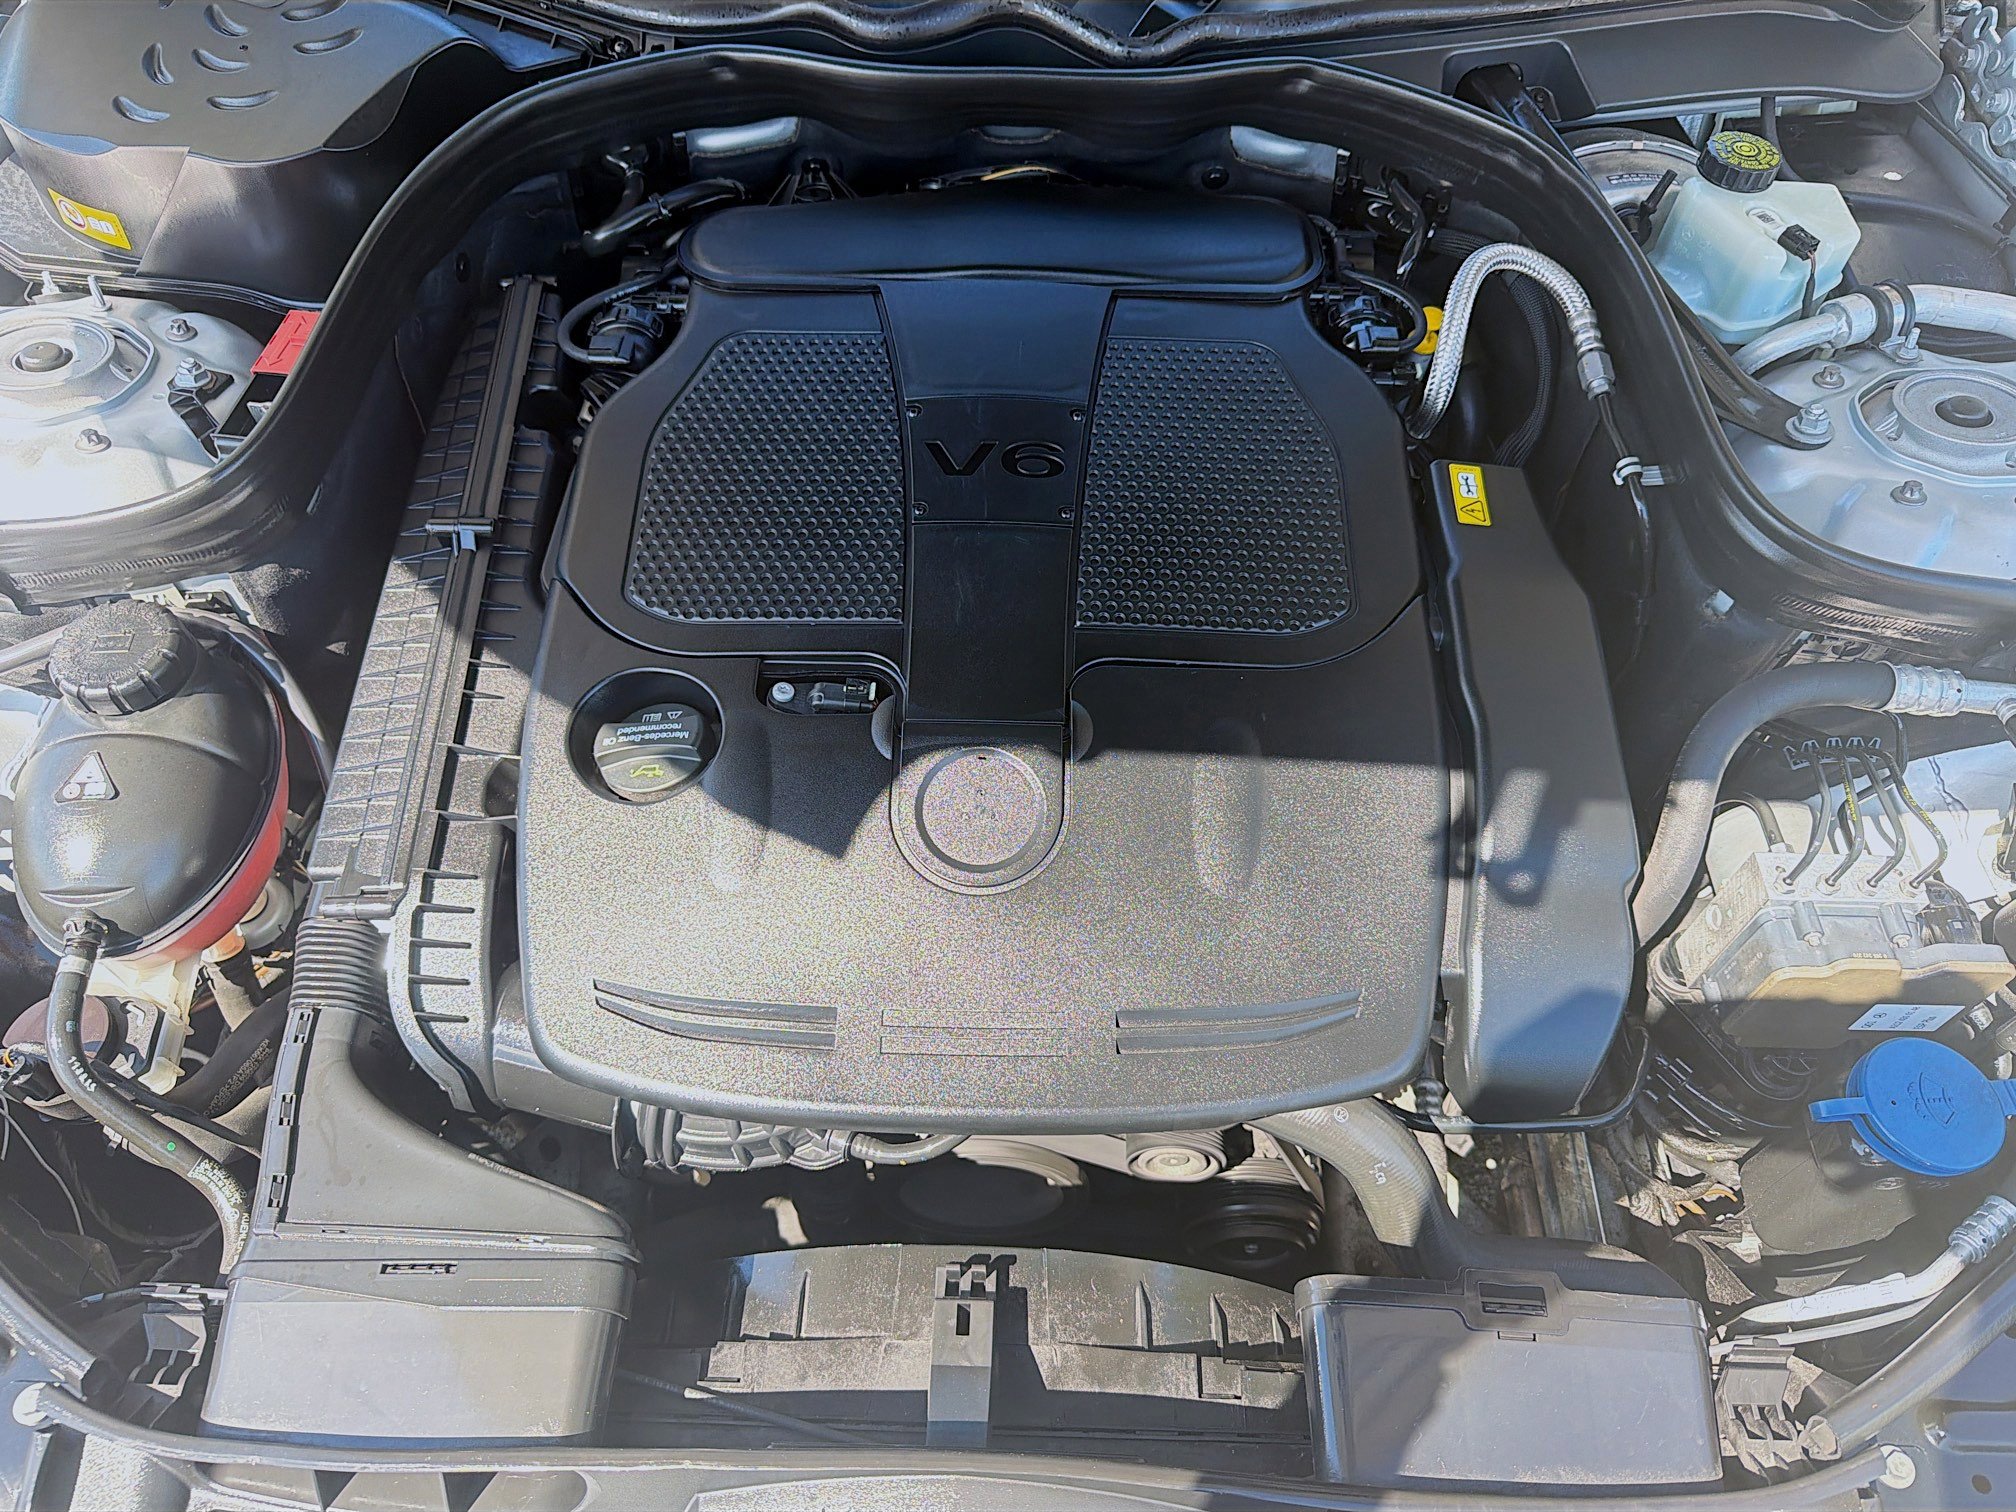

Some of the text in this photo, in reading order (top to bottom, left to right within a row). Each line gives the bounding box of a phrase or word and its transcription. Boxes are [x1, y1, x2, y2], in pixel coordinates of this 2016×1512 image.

[925, 439, 1067, 480] V6
[616, 722, 682, 736] recommended
[602, 730, 690, 746] Mercedes-Benz Oil
